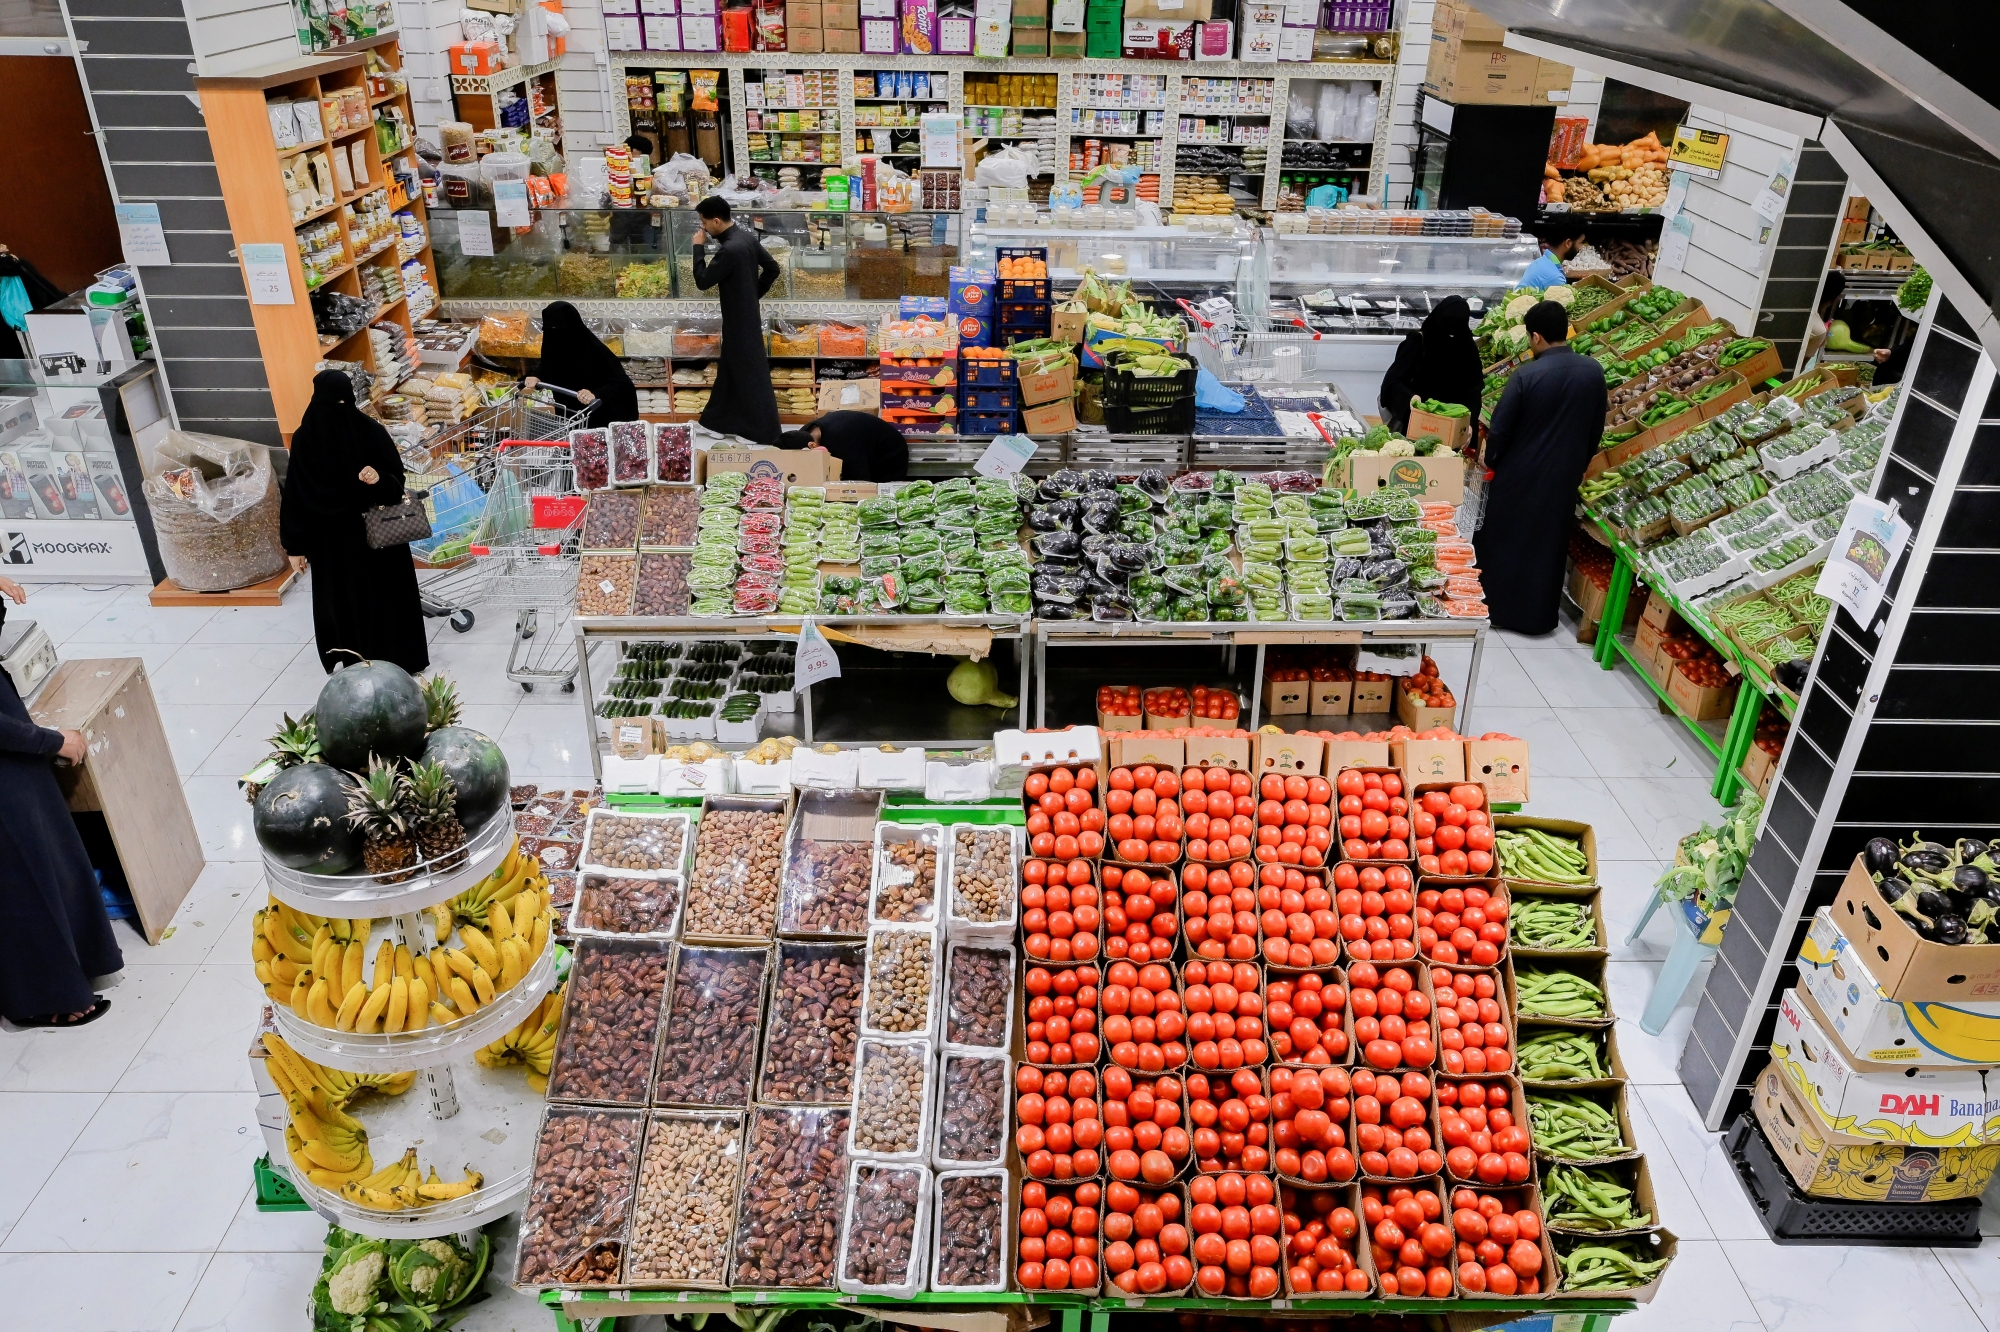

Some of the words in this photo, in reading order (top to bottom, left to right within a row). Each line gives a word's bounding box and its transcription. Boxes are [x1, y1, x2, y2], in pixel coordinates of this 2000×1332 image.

[994, 464, 1005, 475] 75
[32, 542, 111, 554] MOOGMAX
[807, 659, 829, 673] 9.95
[1781, 999, 1803, 1032] DAH
[1879, 1093, 1940, 1116] DAH
[1949, 1098, 2000, 1117] Banana
